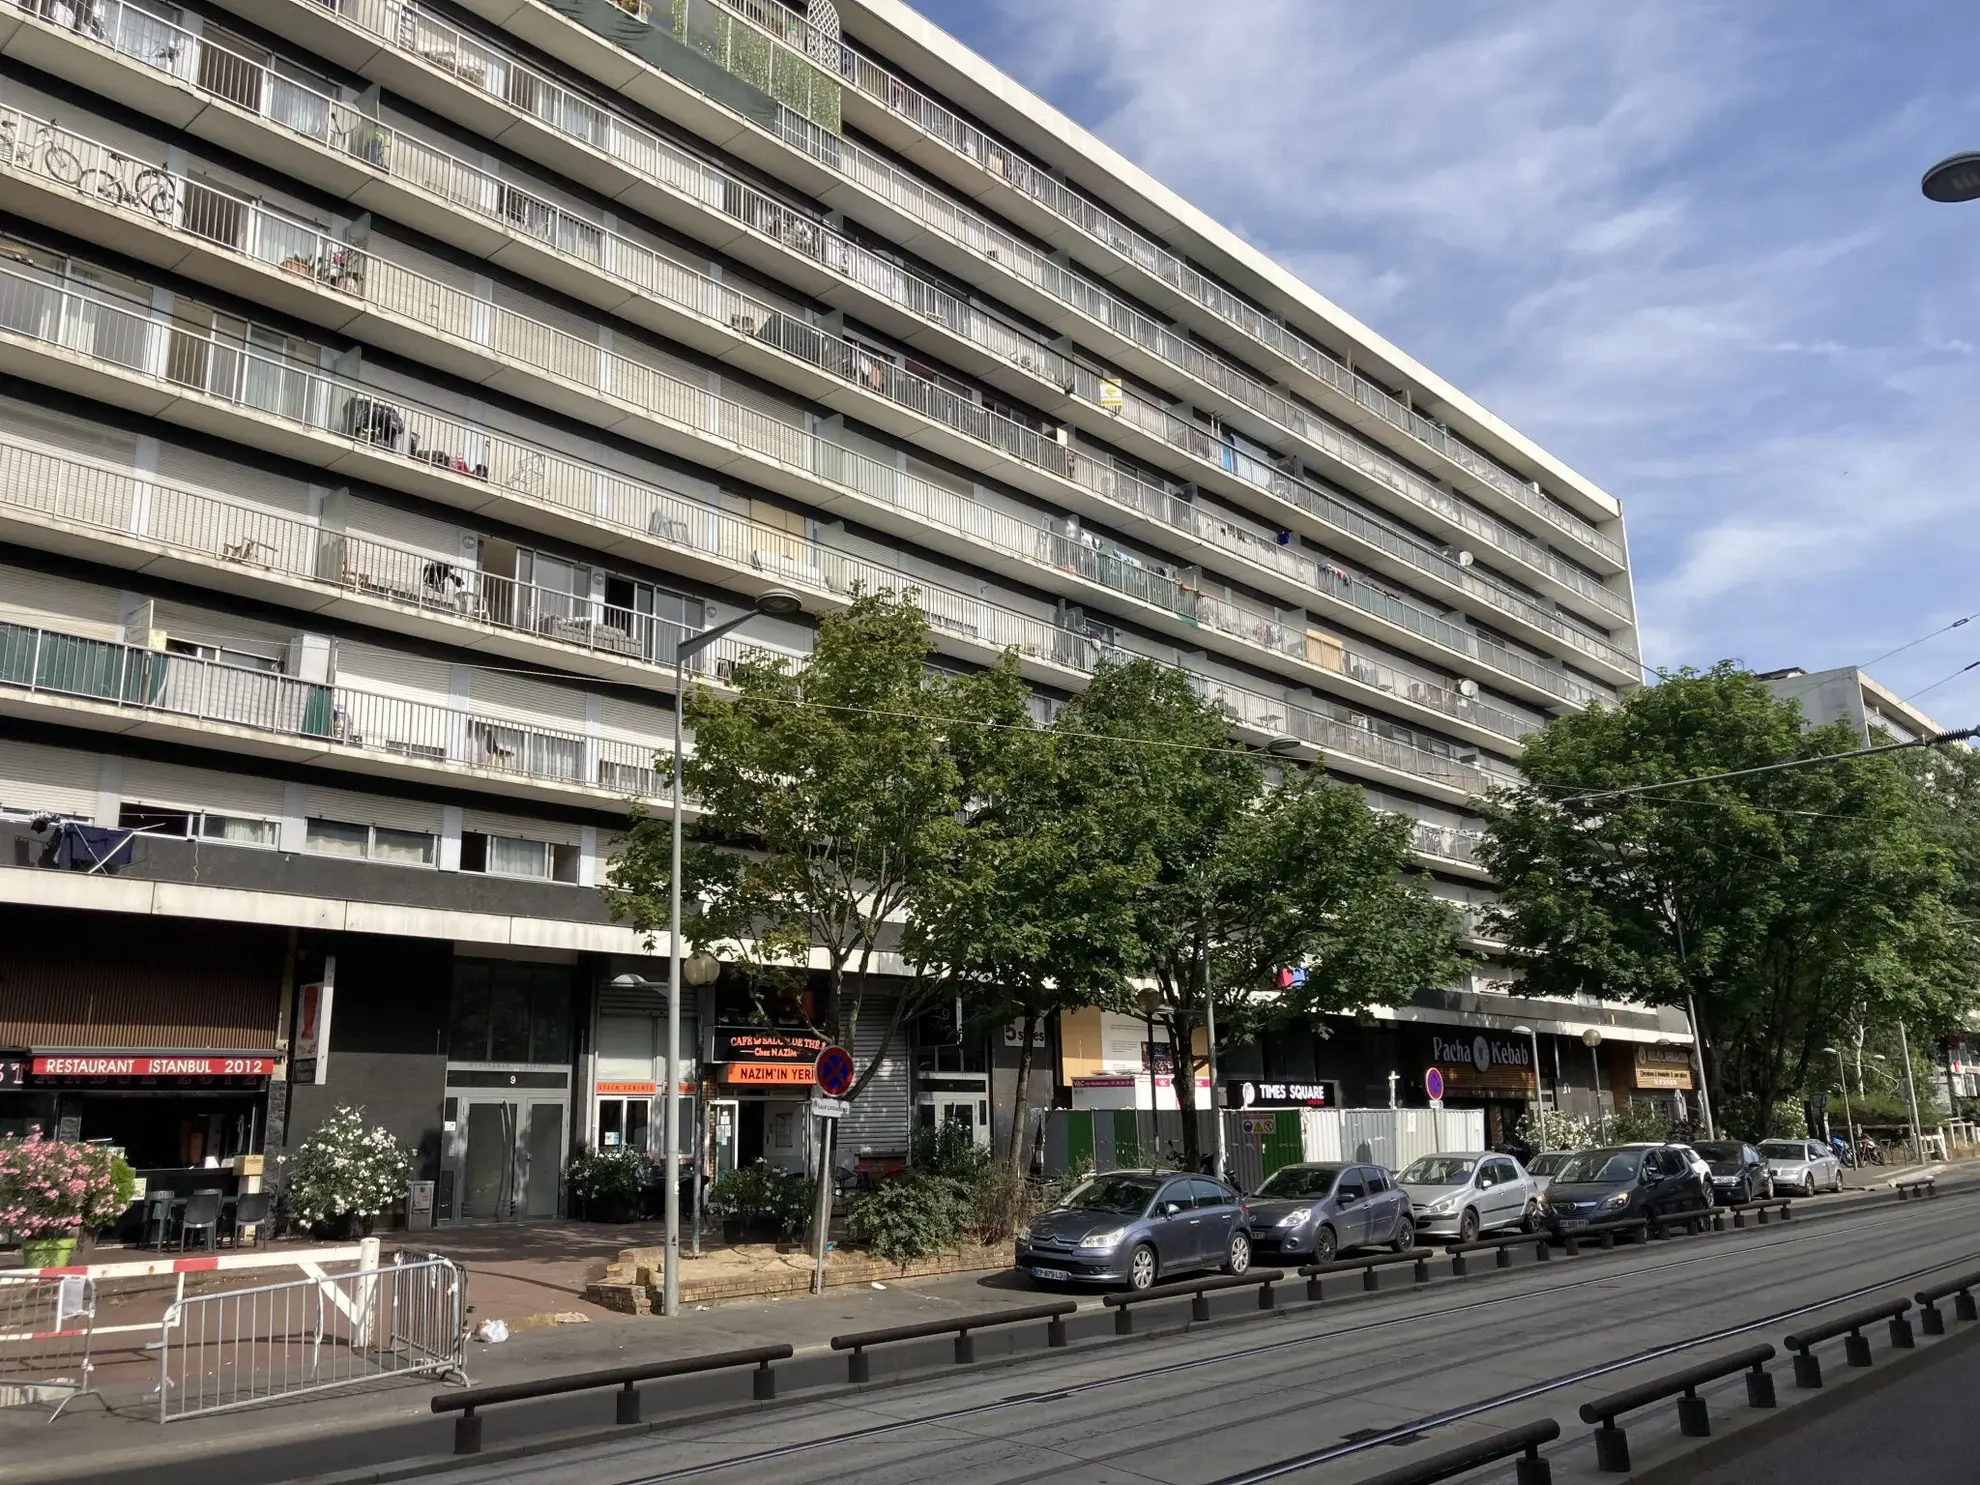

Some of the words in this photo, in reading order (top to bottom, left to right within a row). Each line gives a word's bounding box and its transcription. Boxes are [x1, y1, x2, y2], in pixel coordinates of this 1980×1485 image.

[730, 1035, 753, 1047] CAFÉ
[1018, 1030, 1044, 1042] ses
[754, 1047, 771, 1057] Chez
[1432, 1036, 1472, 1062] Pacha
[1491, 1040, 1529, 1066] Kebab
[46, 1059, 135, 1073] RESTAURANT
[224, 1059, 263, 1073] 2012
[740, 1067, 788, 1080] NAZIM'IN
[509, 1075, 517, 1085] 9
[1259, 1084, 1286, 1099] TIMES
[1289, 1085, 1325, 1100] SQUARE
